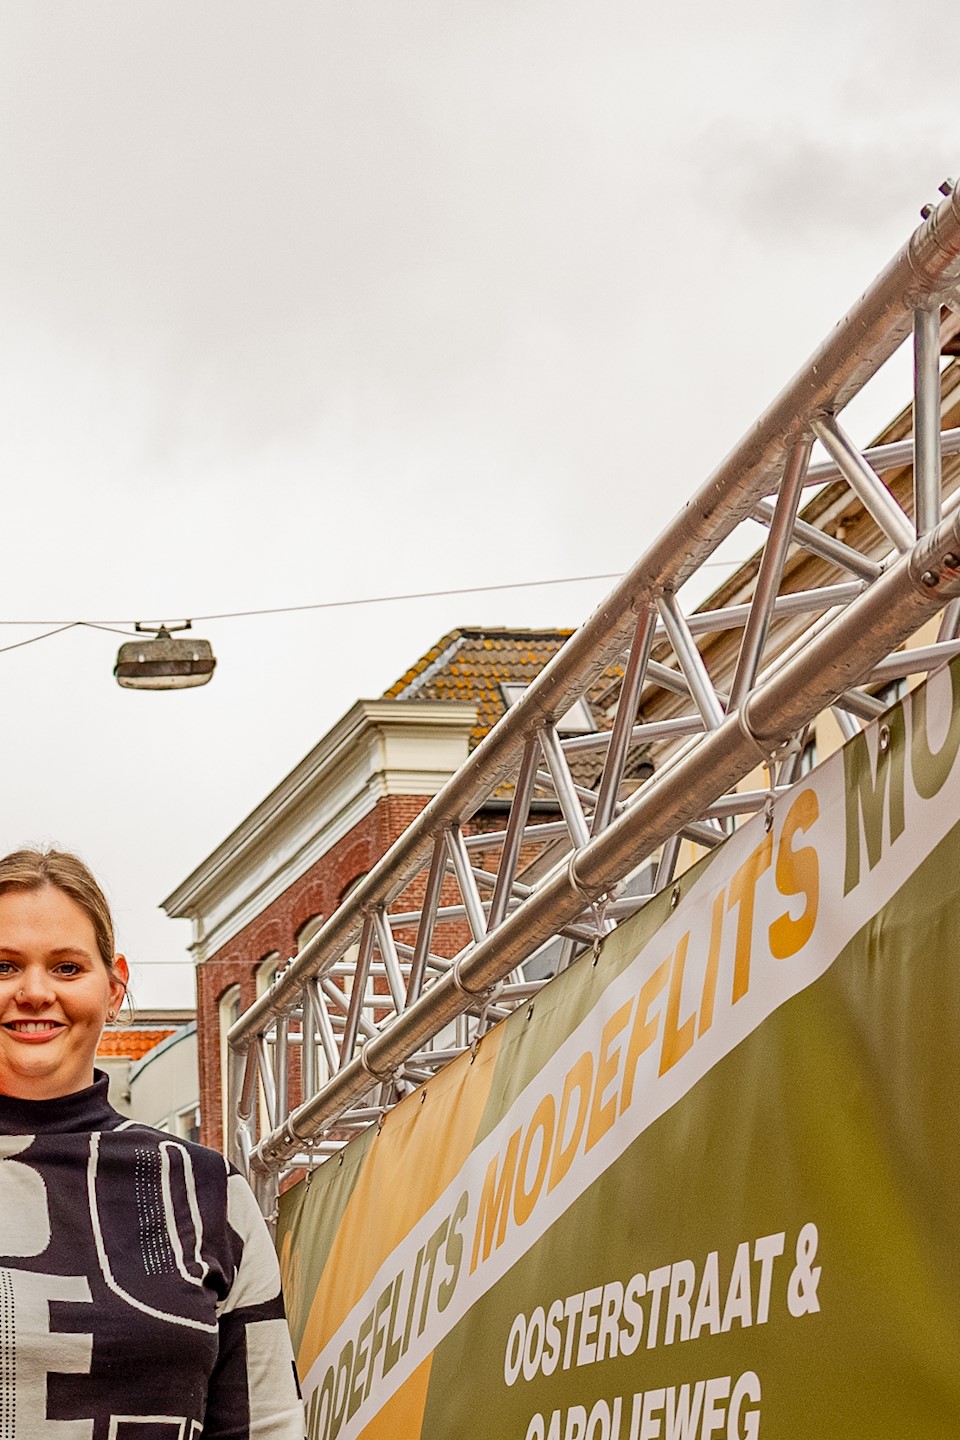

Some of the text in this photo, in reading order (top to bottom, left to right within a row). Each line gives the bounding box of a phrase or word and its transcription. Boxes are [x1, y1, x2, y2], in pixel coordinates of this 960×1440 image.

[469, 788, 820, 1277] MODEFLITS
[504, 1222, 823, 1387] OOSTERSTRAAT &
